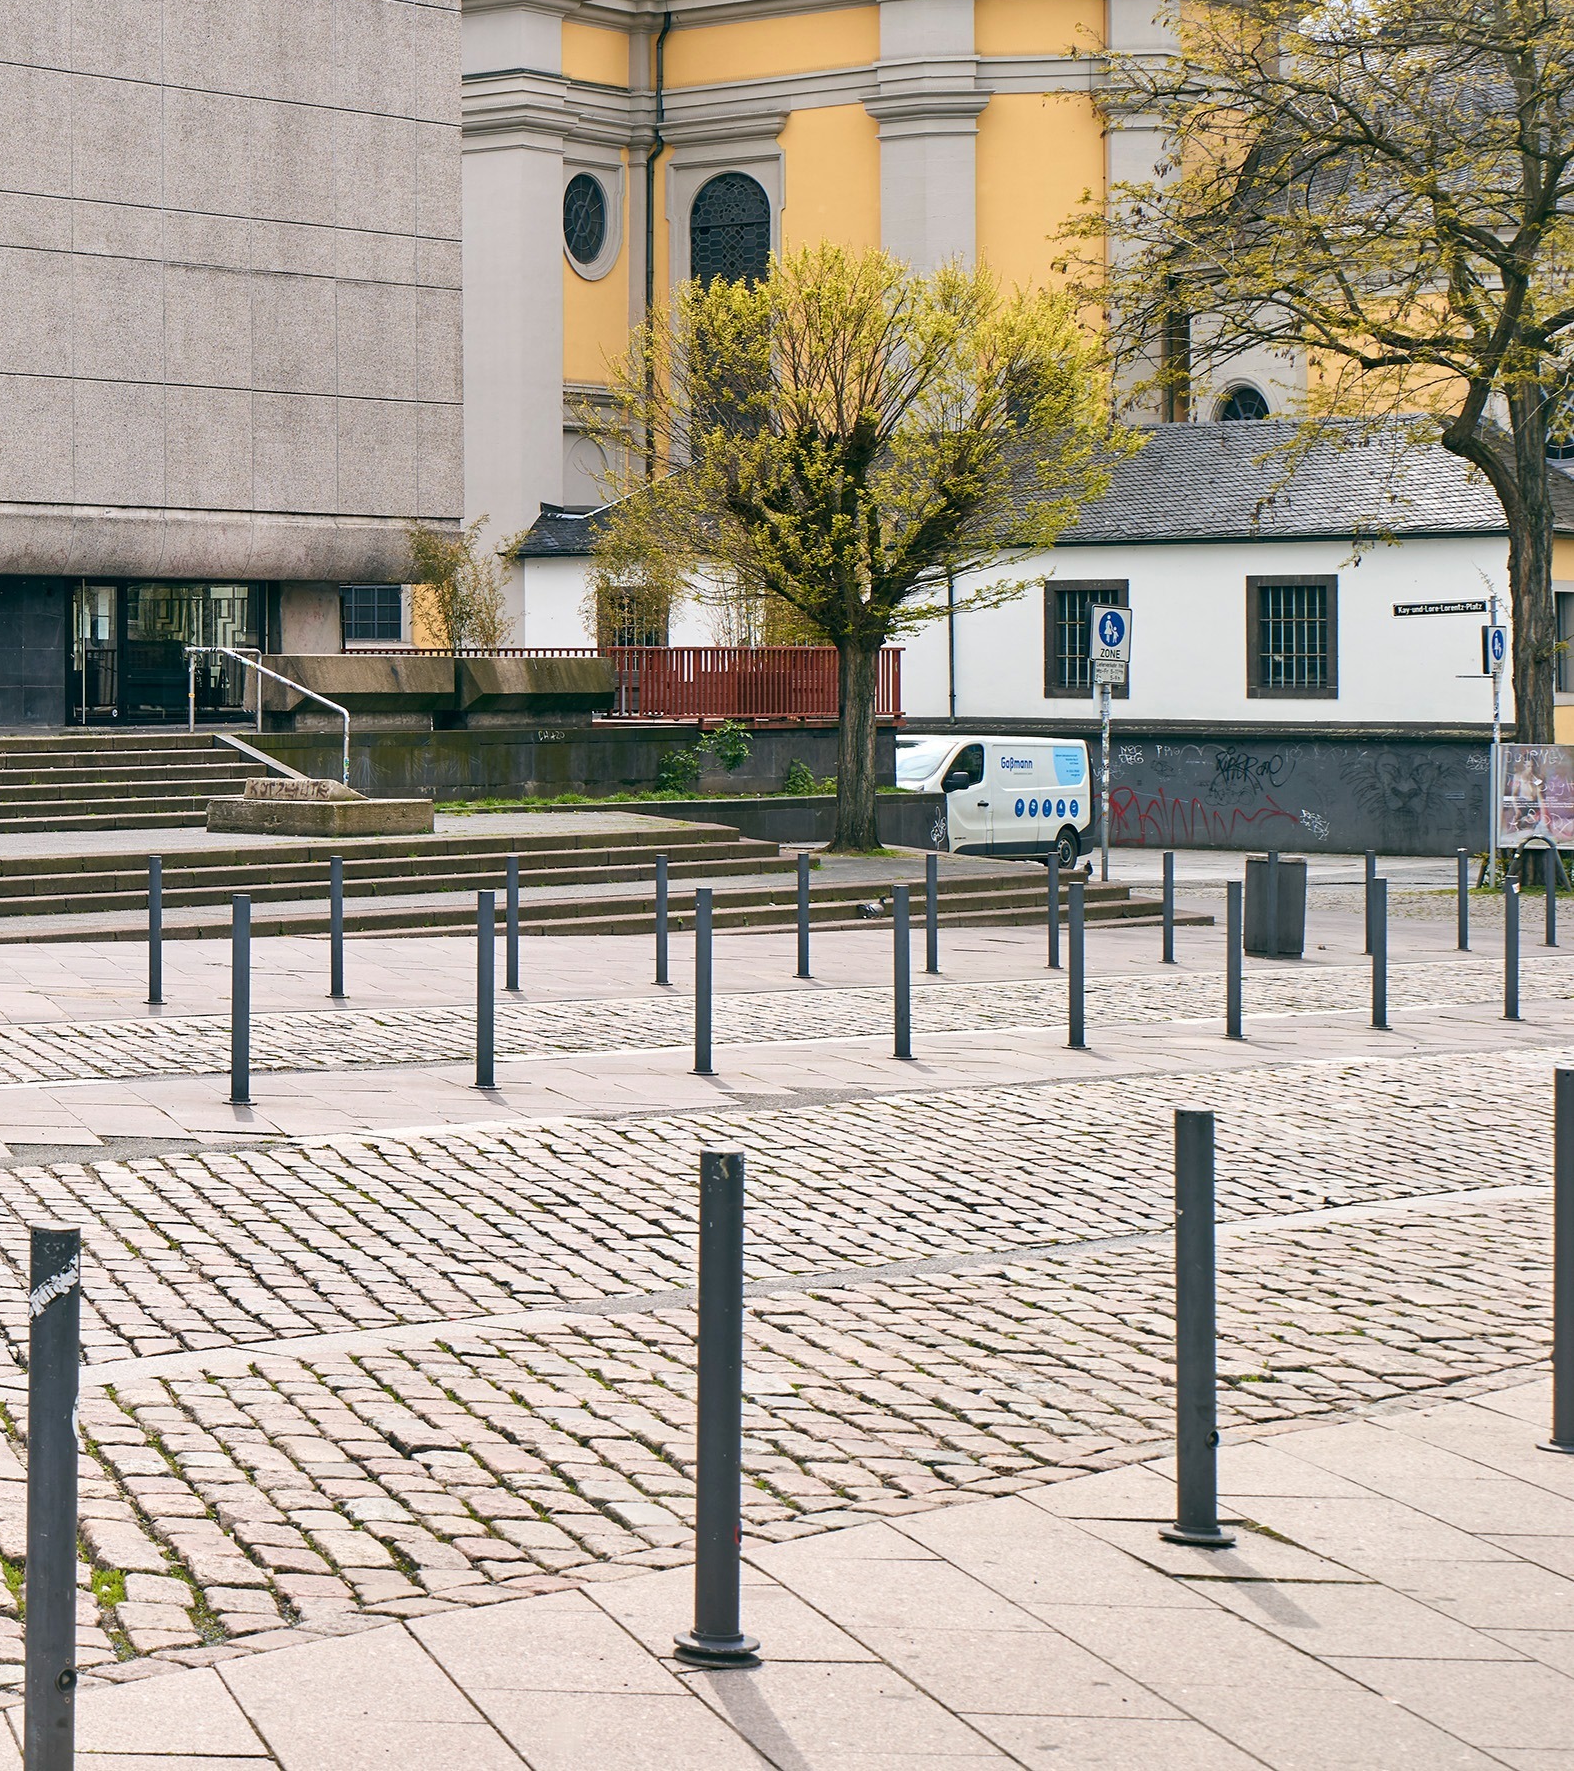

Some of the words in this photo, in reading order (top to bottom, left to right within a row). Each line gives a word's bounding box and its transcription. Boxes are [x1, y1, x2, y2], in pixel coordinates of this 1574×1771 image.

[1397, 602, 1482, 615] Kay-und-Lore-Lorentz-Platz
[1100, 648, 1121, 659] ZONE
[1000, 756, 1033, 772] Gaßmann
